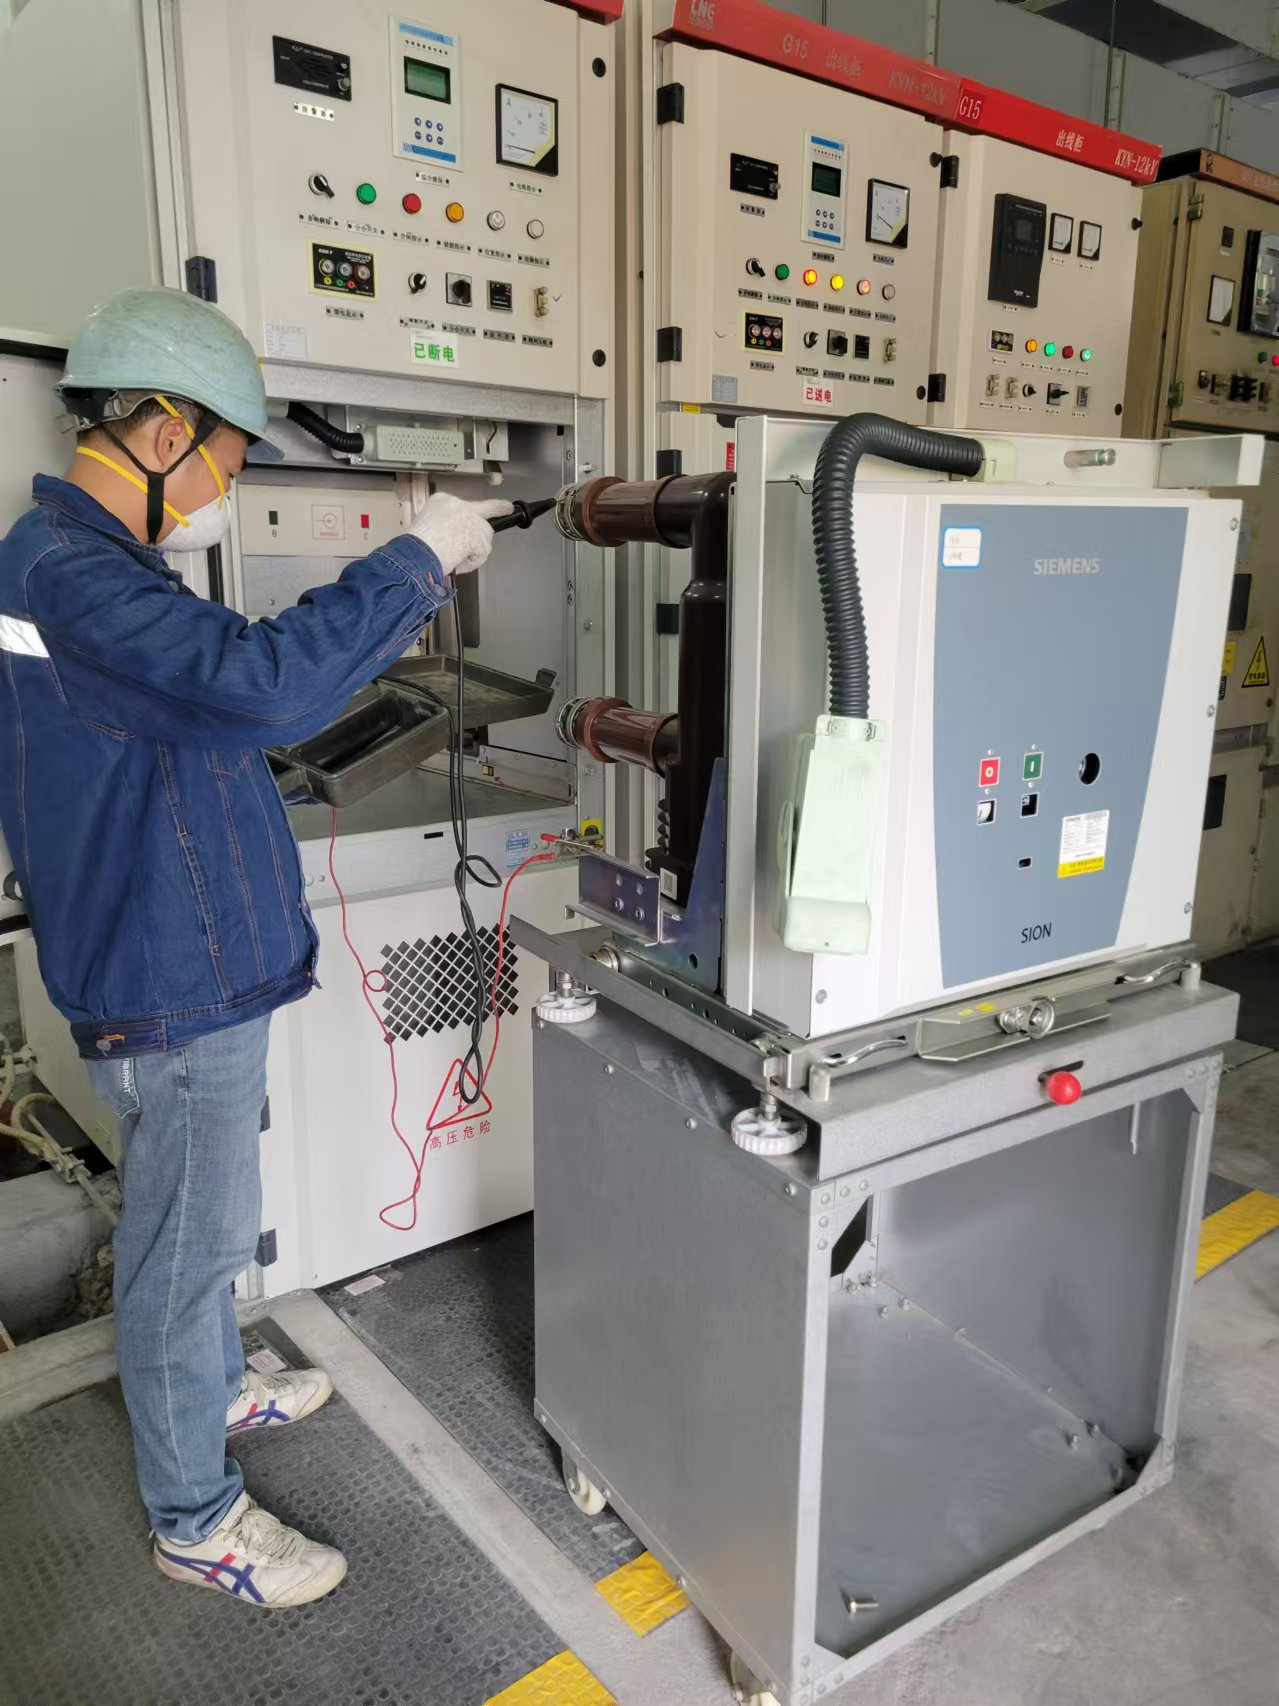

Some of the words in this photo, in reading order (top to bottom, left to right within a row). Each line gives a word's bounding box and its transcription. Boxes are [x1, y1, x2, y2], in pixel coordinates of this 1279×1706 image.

[959, 96, 981, 120] G15
[1055, 129, 1084, 152] 出线柜
[1114, 148, 1160, 176] KYN-12kV
[414, 342, 456, 362] 已断电
[806, 387, 832, 403] 已送电
[1033, 558, 1100, 576] SIEMENS
[1021, 922, 1052, 943] SION
[430, 1120, 491, 1149] 高压危险
